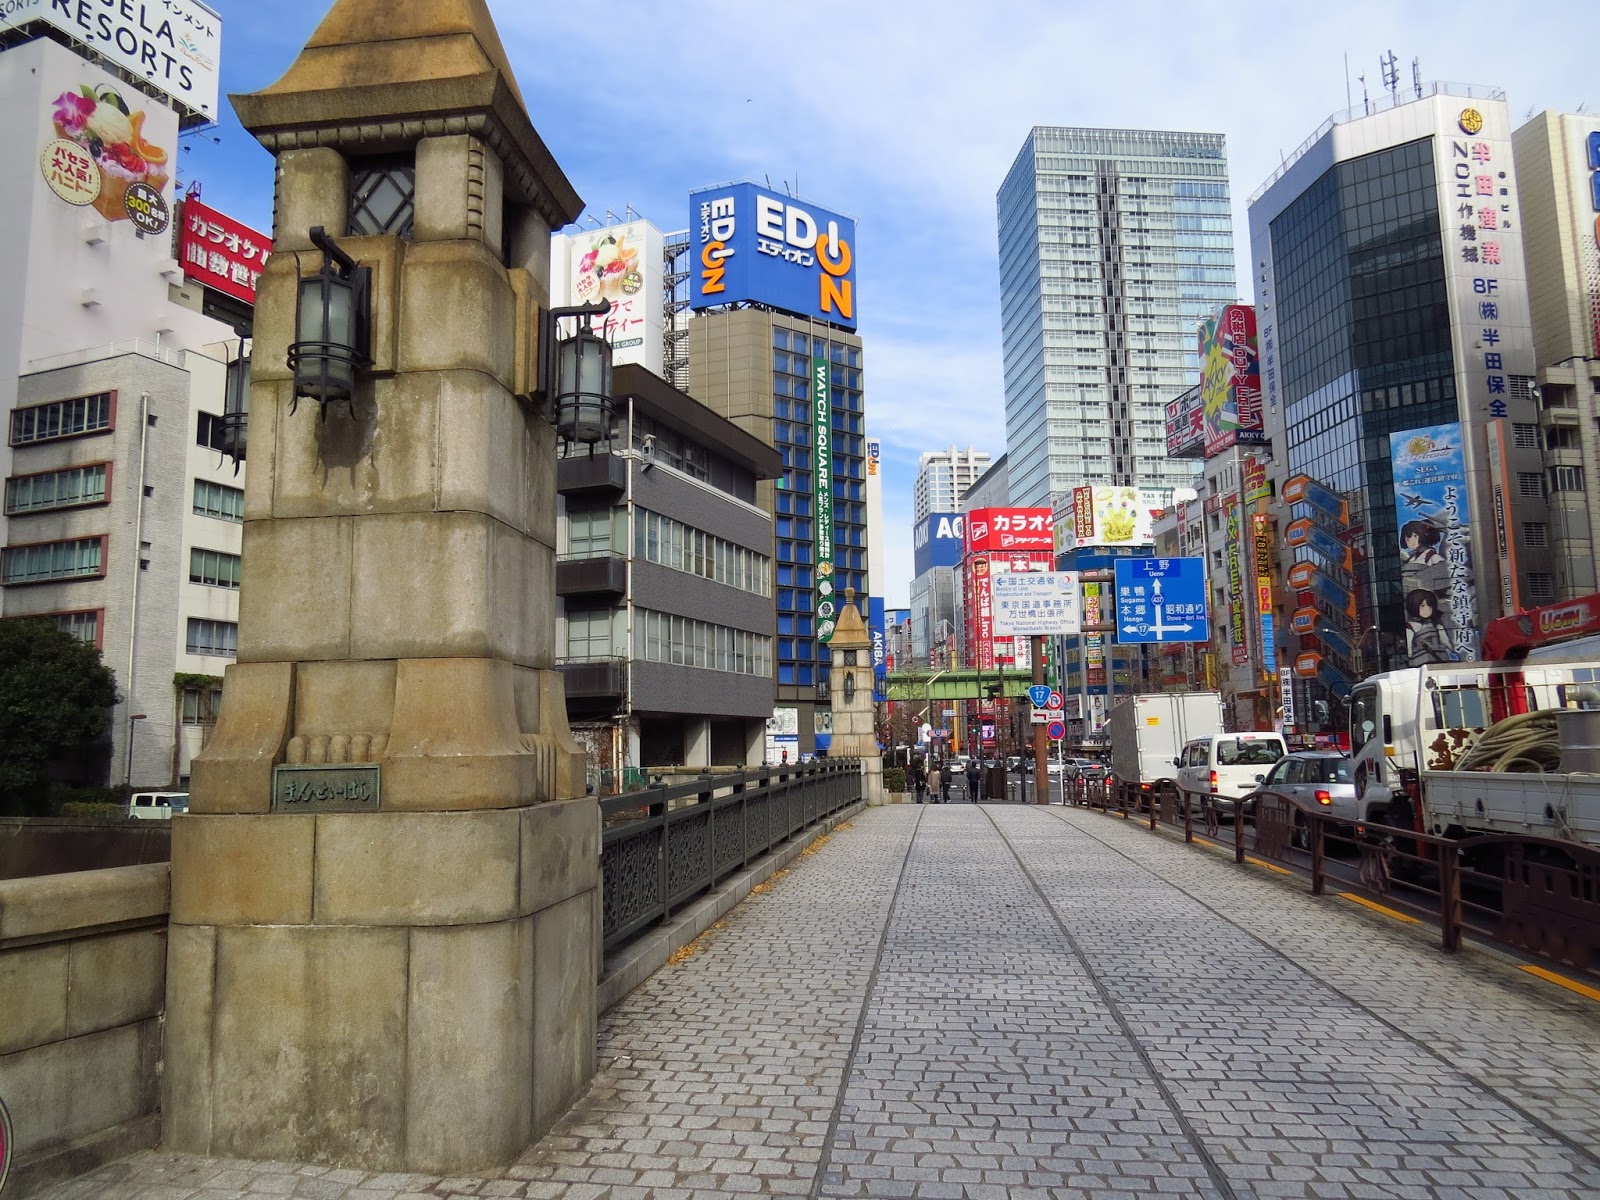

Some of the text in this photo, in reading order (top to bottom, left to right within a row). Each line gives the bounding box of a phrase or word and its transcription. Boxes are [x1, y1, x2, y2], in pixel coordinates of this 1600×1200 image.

[54, 146, 90, 170] パセラ
[1471, 142, 1501, 265] 半田産業
[136, 211, 159, 230] OK!
[700, 201, 710, 243] エディオン
[756, 194, 852, 319] EDION
[757, 238, 814, 267] エディオン
[1472, 278, 1499, 294] 8F
[1235, 385, 1252, 425] FREE
[816, 365, 829, 490] WATCH SQUARE
[1239, 431, 1260, 439] AKKY
[1415, 464, 1438, 474] SEGA
[914, 517, 929, 550] AOKI
[1225, 502, 1240, 595] TAX FREE
[1143, 559, 1169, 570] 上野
[1008, 576, 1055, 586] 国土交通省
[1001, 599, 1072, 609] 東京国道事務所
[1008, 609, 1065, 618] 万世橋出張所
[1120, 605, 1146, 615] 本郷
[1165, 604, 1204, 614] 昭和通り
[873, 631, 884, 667] AKIBA
[1035, 690, 1045, 699] 17
